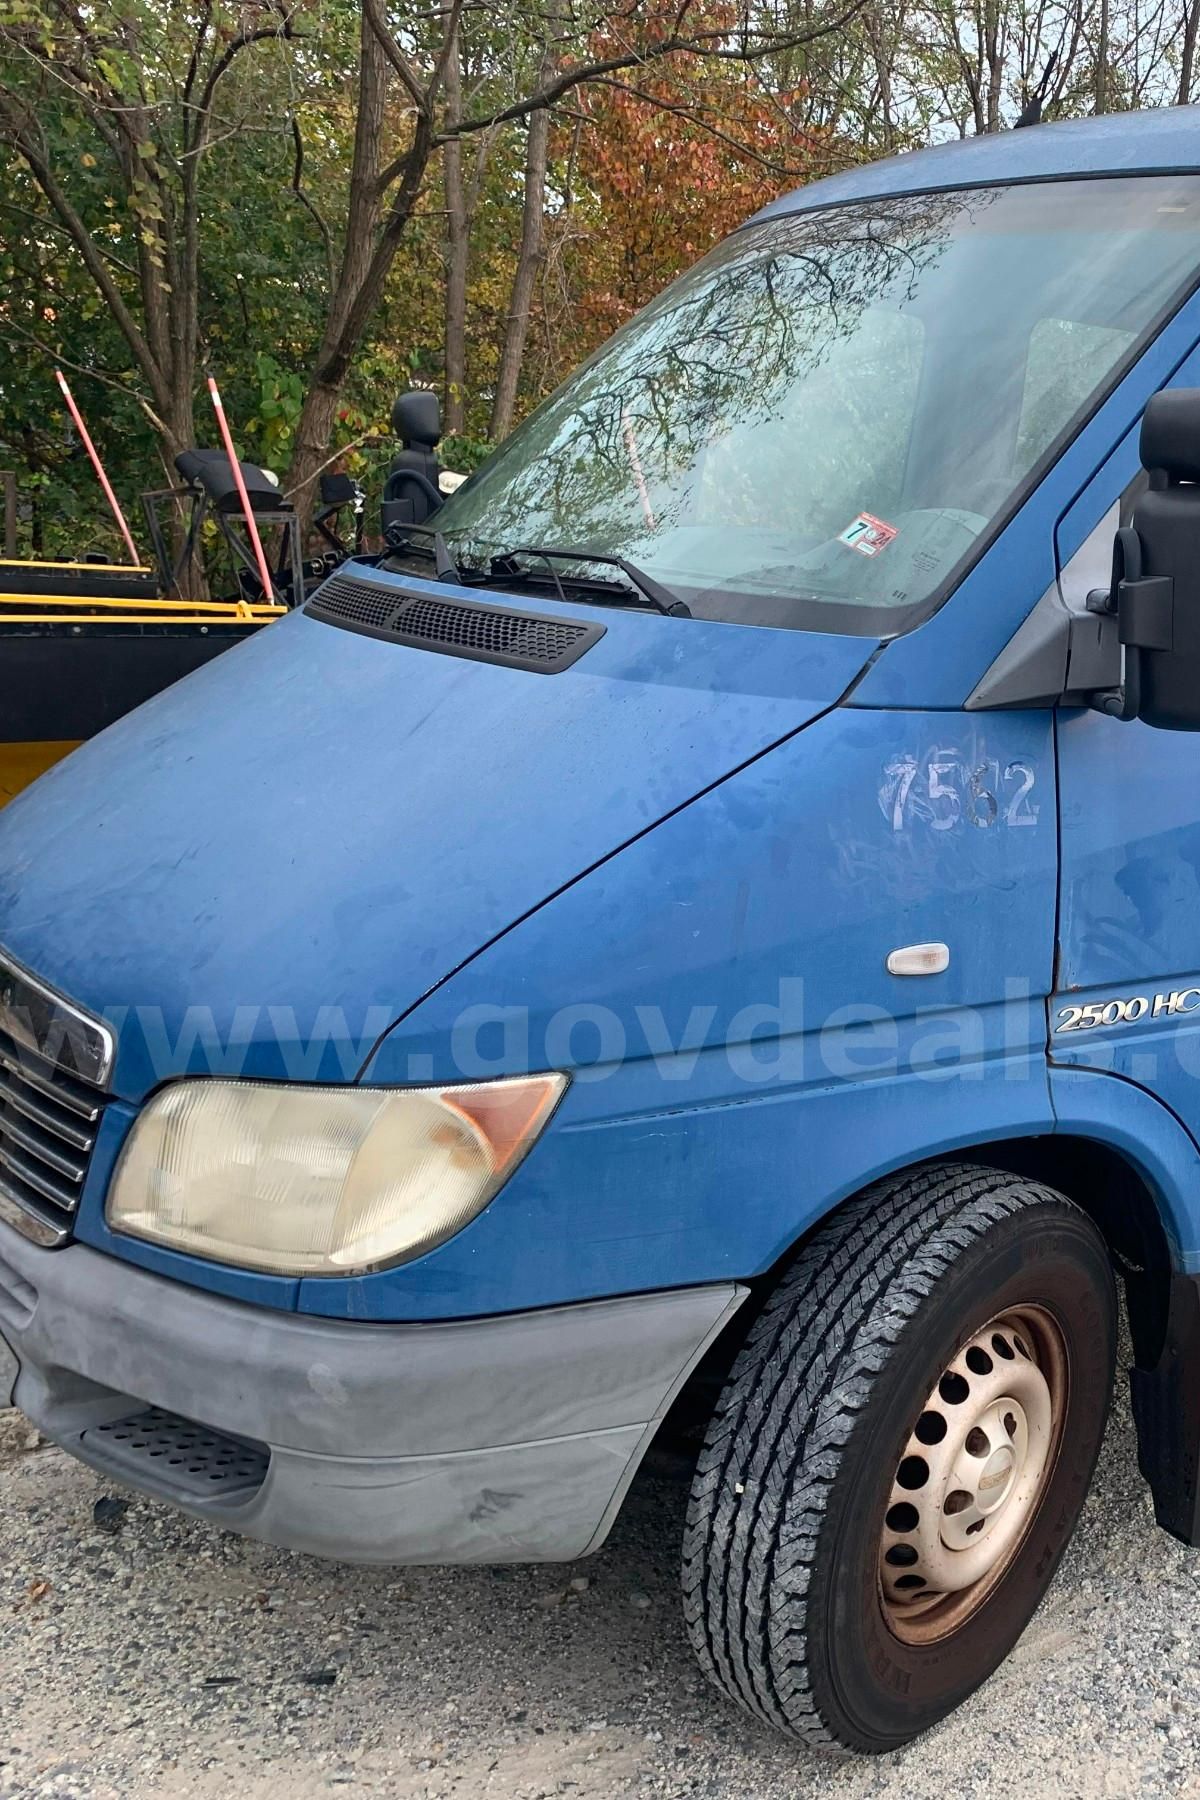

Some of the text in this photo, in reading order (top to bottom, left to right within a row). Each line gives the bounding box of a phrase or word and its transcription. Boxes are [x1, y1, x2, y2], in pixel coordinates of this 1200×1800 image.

[847, 522, 868, 540] 7
[882, 761, 1041, 831] 7562
[1055, 996, 1149, 1033] 2500
